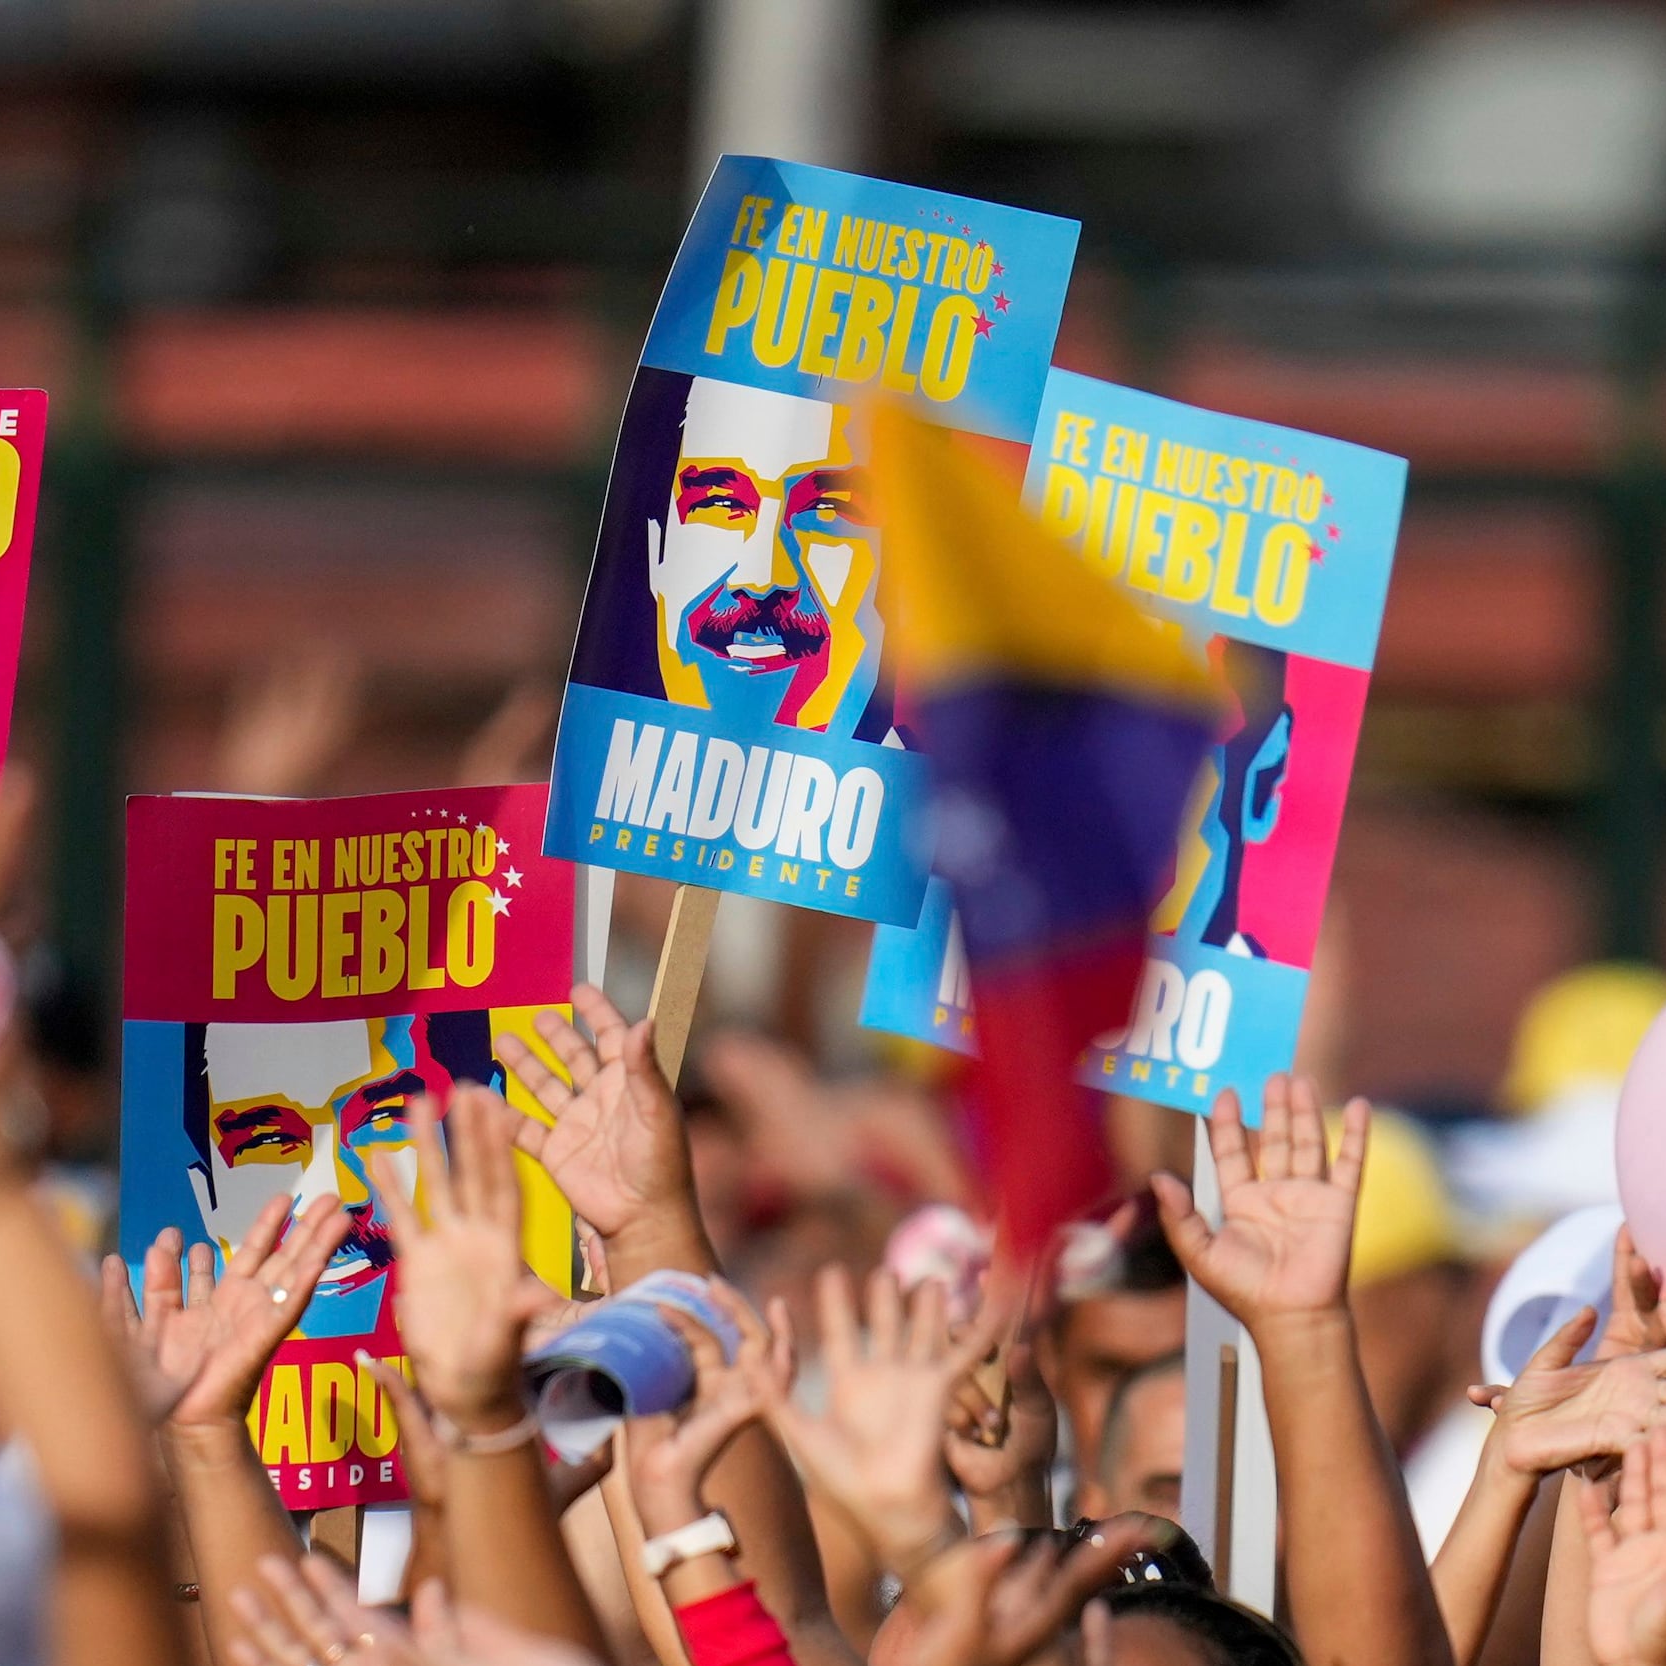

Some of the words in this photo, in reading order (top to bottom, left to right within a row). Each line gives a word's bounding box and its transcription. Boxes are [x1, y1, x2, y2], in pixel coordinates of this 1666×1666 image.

[731, 195, 773, 249] FE
[776, 203, 828, 261] EN
[832, 214, 994, 294] NUESTRO
[704, 249, 980, 402] PUEBLO
[1051, 410, 1096, 467] FE
[1100, 423, 1149, 482] EN
[1153, 440, 1324, 523] NUESTRO
[1039, 463, 1313, 627] PUEBLO
[594, 718, 884, 870] MADURO
[214, 838, 257, 890] FE
[272, 839, 320, 890] EN
[334, 826, 496, 888] NUESTRO
[588, 823, 861, 897] PRESIDENTE
[212, 880, 496, 1001] PUEBLO
